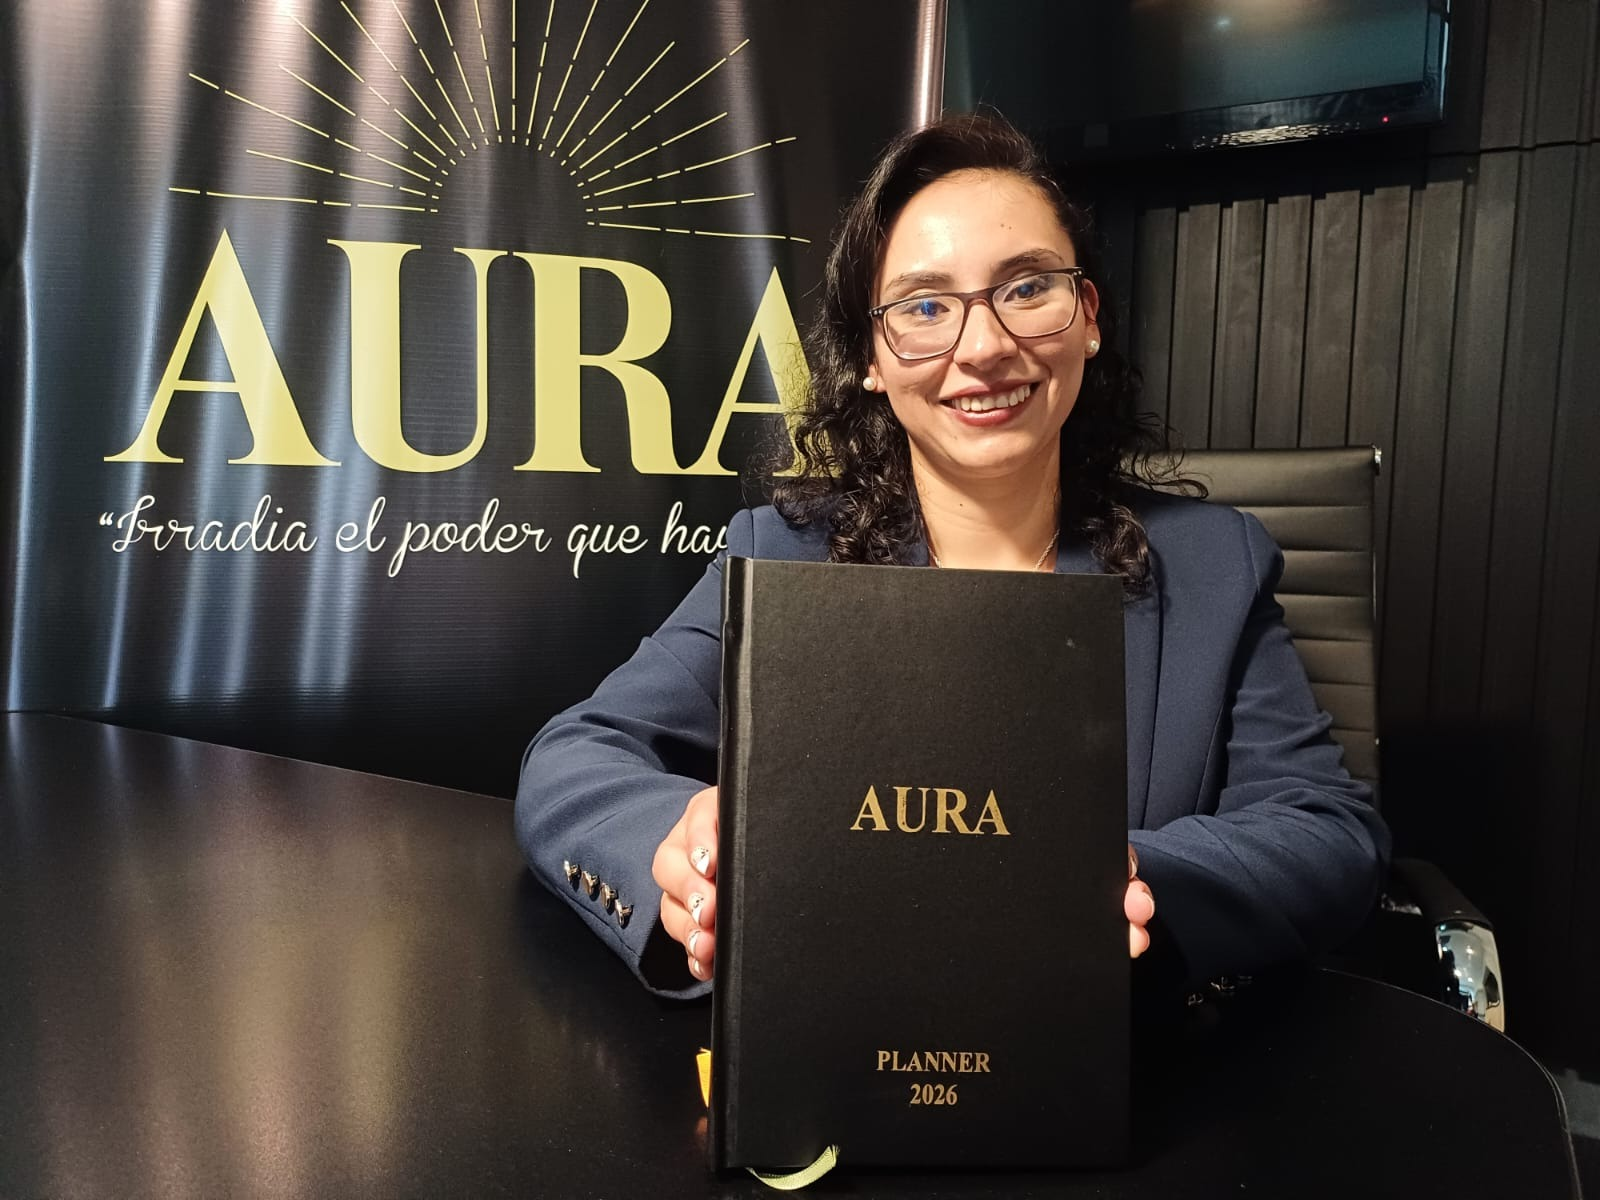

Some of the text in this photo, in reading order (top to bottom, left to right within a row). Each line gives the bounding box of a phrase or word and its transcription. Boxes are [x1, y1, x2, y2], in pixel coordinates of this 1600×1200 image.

[103, 229, 846, 477] AURA
[335, 496, 388, 554] el
[387, 496, 552, 578] poder
[566, 518, 648, 579] que
[849, 784, 1011, 836] AURA
[876, 1050, 991, 1073] PLANNER
[909, 1083, 958, 1106] 2026
